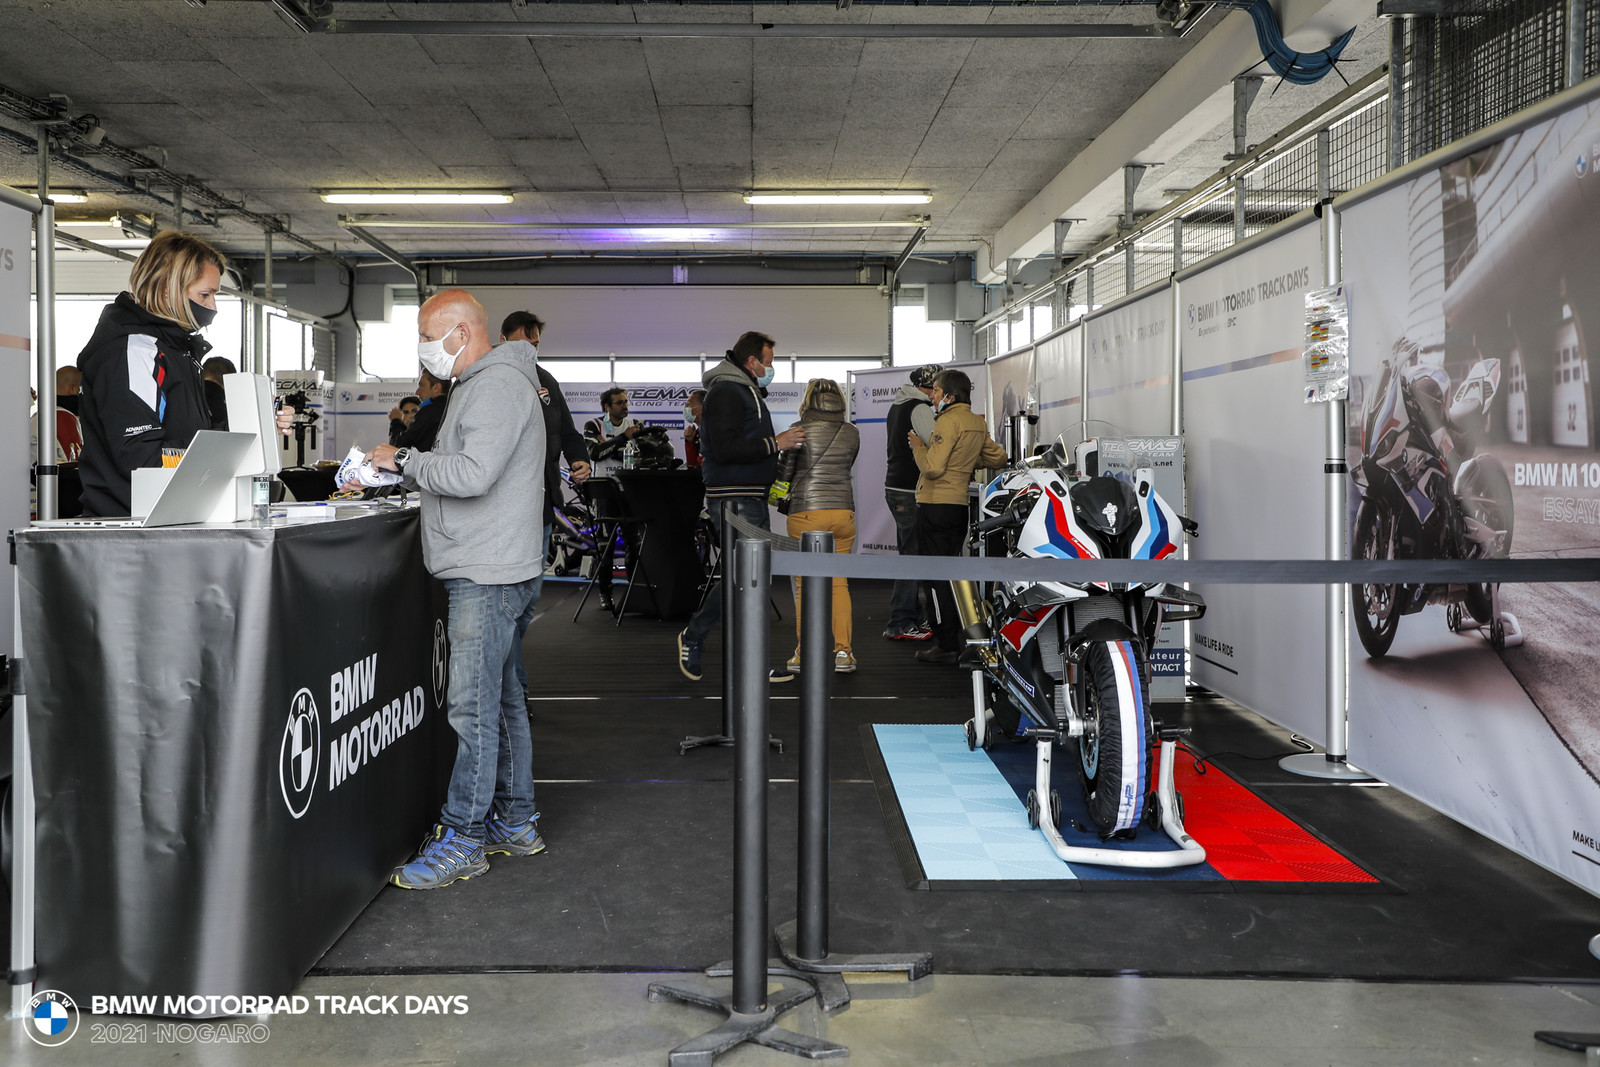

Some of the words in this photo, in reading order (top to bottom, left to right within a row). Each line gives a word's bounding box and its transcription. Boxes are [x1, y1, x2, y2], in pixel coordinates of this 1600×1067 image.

[1197, 301, 1214, 322] BMW
[1257, 275, 1286, 302] TRACK
[1286, 266, 1309, 292] DAYS
[872, 388, 890, 397] BMW
[1514, 463, 1558, 487] BMW
[1561, 463, 1578, 487] M
[1149, 651, 1180, 660] uteur
[1194, 633, 1207, 648] MAKE
[1207, 638, 1218, 651] LIFE
[1222, 643, 1234, 658] RIDE
[1151, 663, 1180, 672] NTACT
[331, 652, 378, 724] BMW
[329, 685, 425, 792] MOTORRAD
[1572, 829, 1595, 850] MAKE
